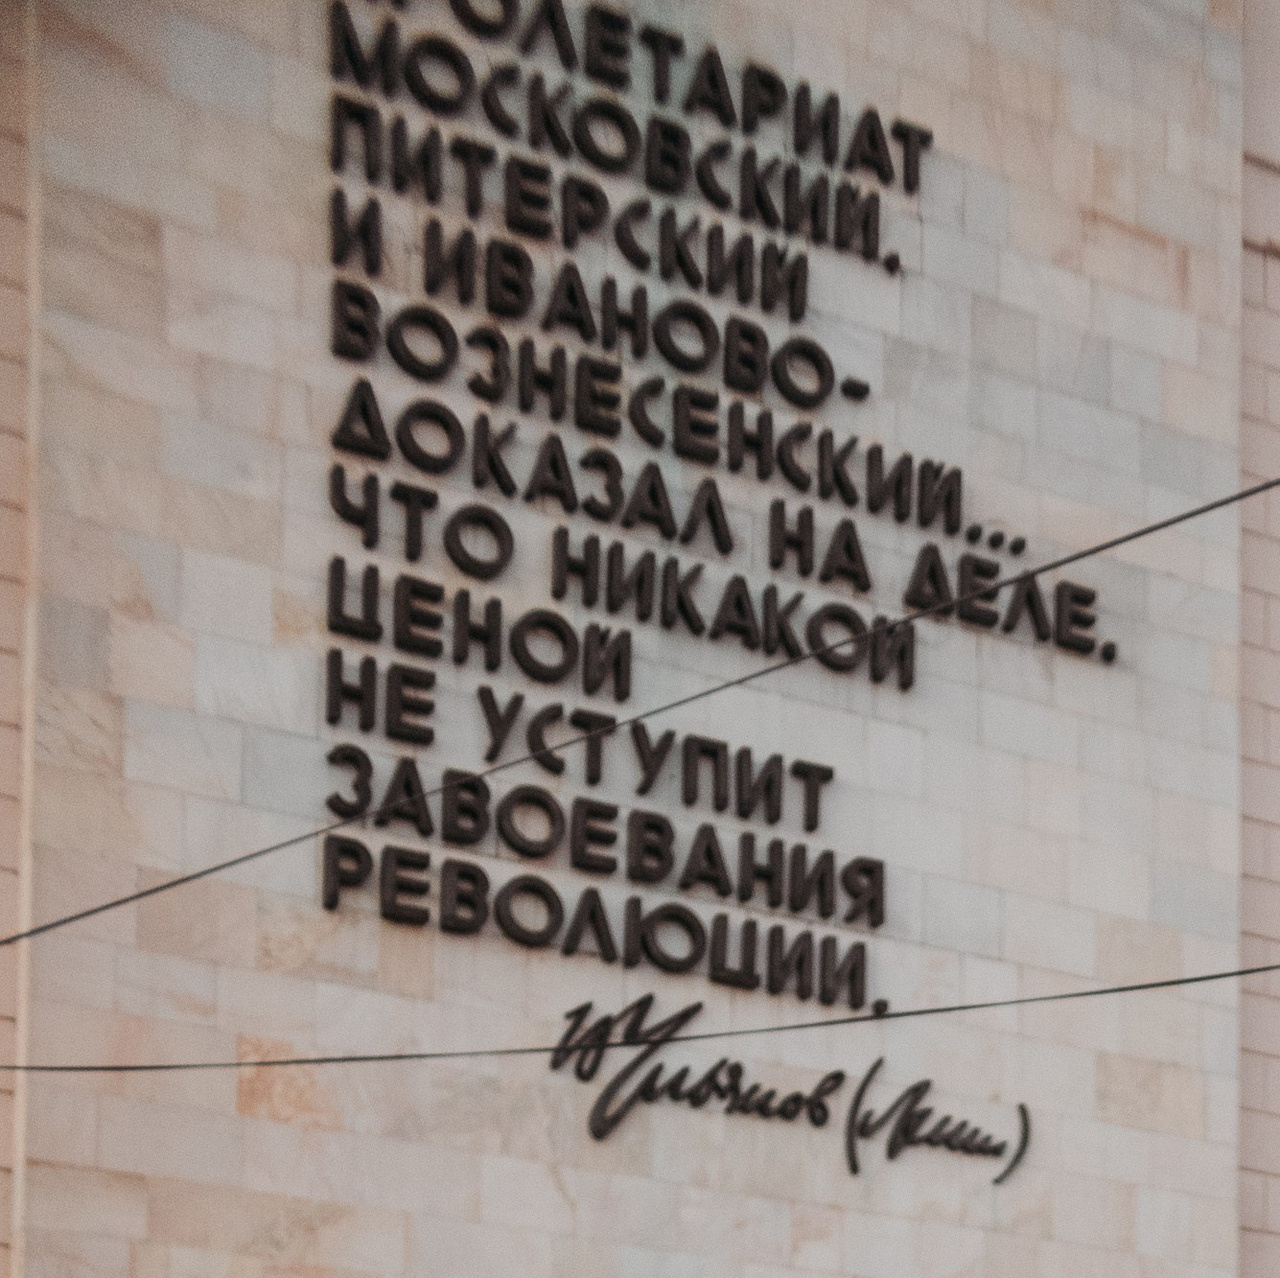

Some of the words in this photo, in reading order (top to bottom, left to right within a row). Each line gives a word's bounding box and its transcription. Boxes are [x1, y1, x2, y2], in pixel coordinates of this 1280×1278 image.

[330, 0, 901, 275] МОСКОВСКИЙ.
[331, 95, 809, 324] ПИТЕРСКИЙ
[331, 187, 382, 278] И
[424, 215, 871, 411] ИВАНОВО-
[327, 555, 633, 702] ЦЕНОЙ
[330, 463, 515, 582] ЧТО
[552, 524, 916, 692] НИКАКОЙ
[331, 377, 735, 556] ДОКАЗАЛ
[767, 498, 872, 594] НА
[904, 542, 1118, 665] ДЕЛЕ.
[325, 648, 436, 746] НЕ
[477, 685, 835, 832] УСТУПИТ
[325, 743, 887, 928] ЗАВОЕВАНИЯ
[321, 835, 889, 1016] РЕВОЛЮЦИИ.
